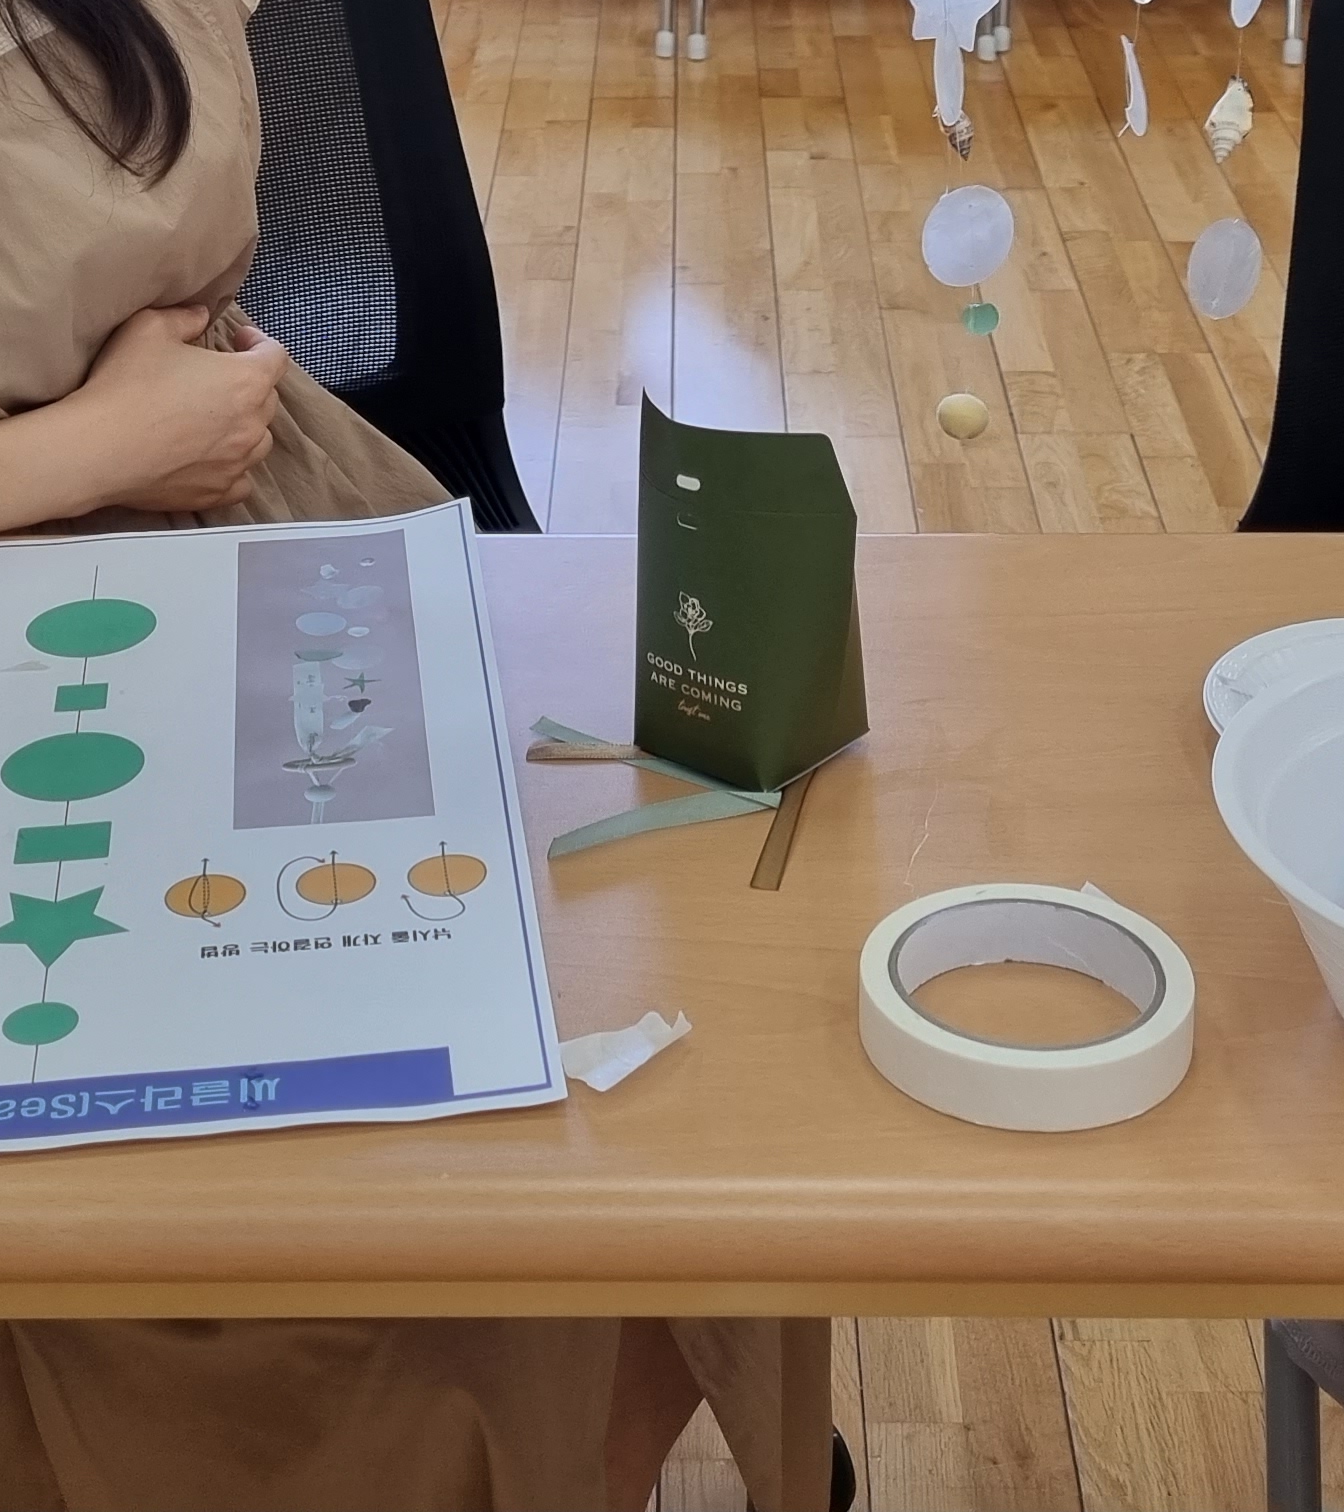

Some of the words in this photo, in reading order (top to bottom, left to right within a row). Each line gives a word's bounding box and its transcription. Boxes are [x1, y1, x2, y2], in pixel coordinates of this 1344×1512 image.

[647, 652, 683, 676] GOOD
[687, 668, 748, 695] THINGS
[650, 671, 676, 691] ARE
[681, 683, 742, 712] COMING
[250, 936, 333, 955] 연결하는
[341, 932, 383, 948] 자개
[200, 943, 241, 959] 방법
